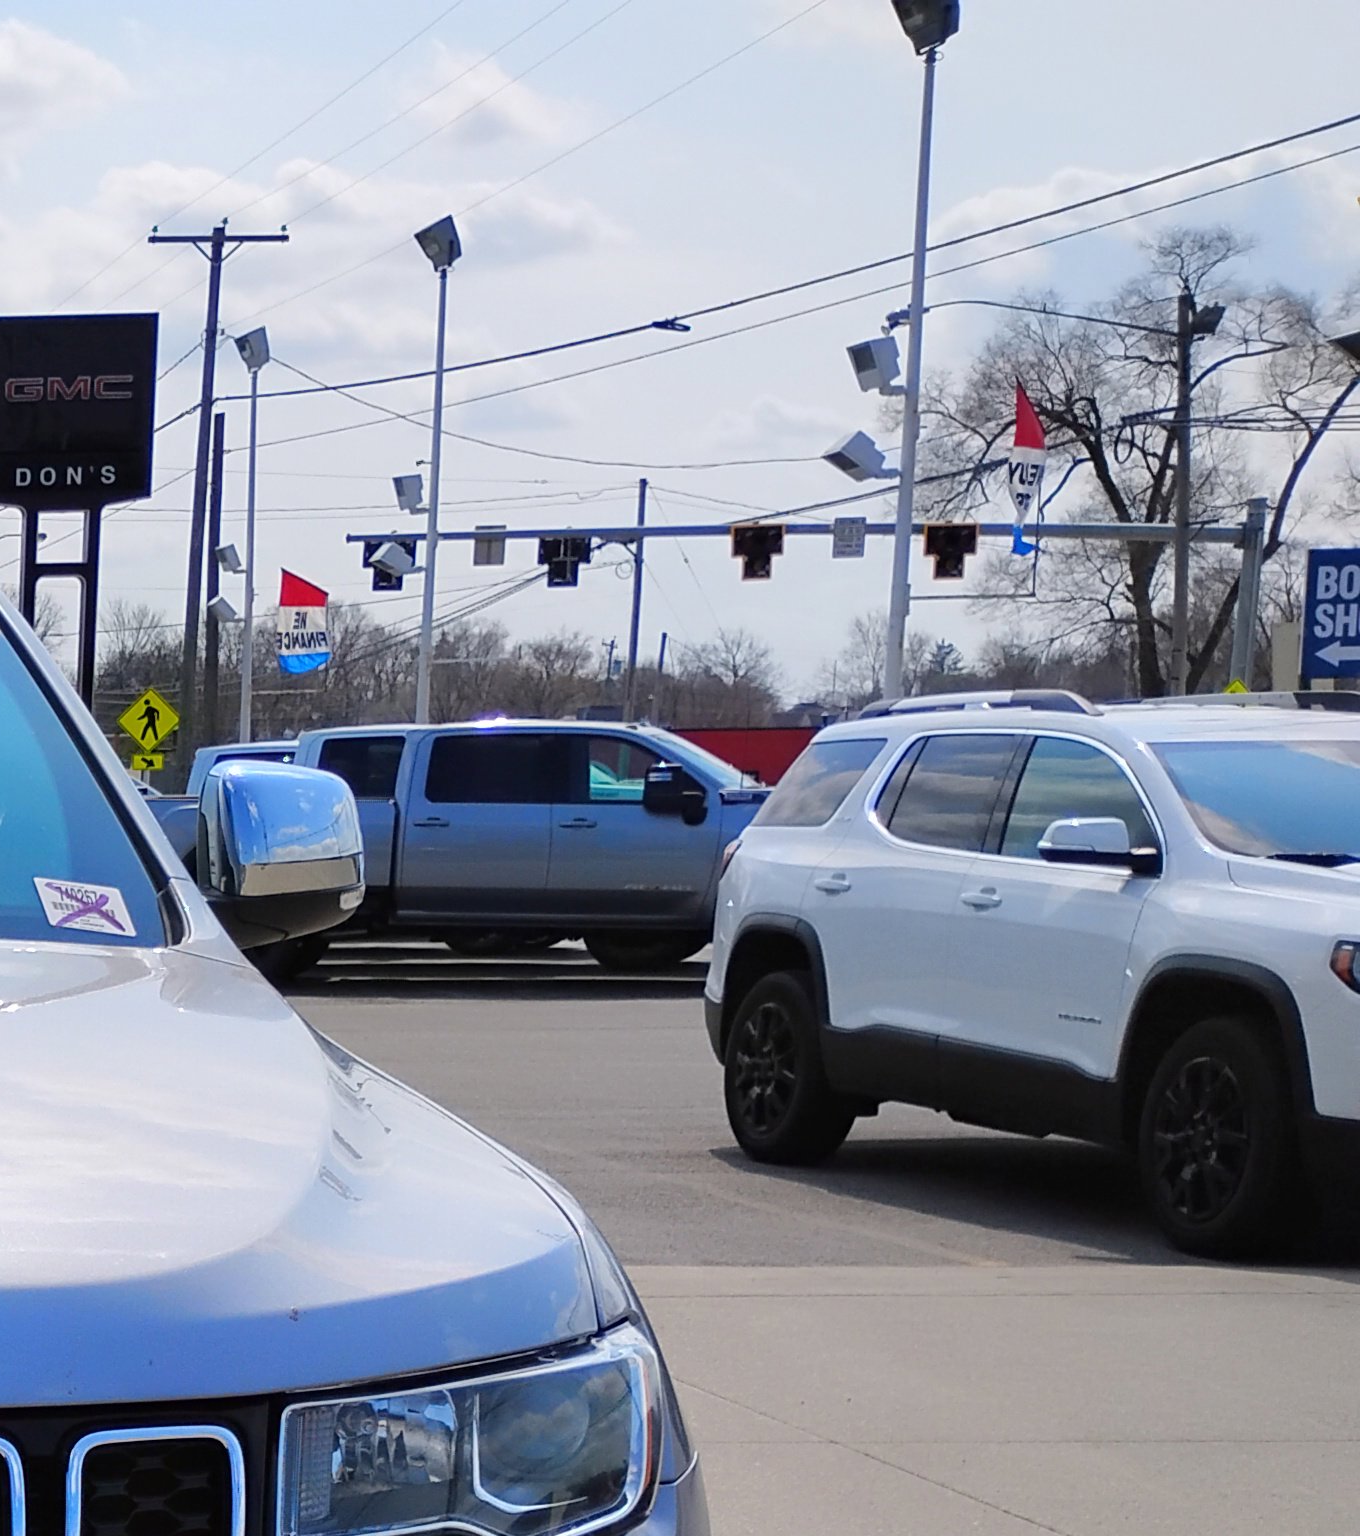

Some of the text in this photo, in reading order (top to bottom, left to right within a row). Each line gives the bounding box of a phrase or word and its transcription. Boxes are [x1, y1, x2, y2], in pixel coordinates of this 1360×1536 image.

[5, 375, 133, 402] GMC
[15, 466, 116, 487] DON'S
[1313, 603, 1360, 638] SH
